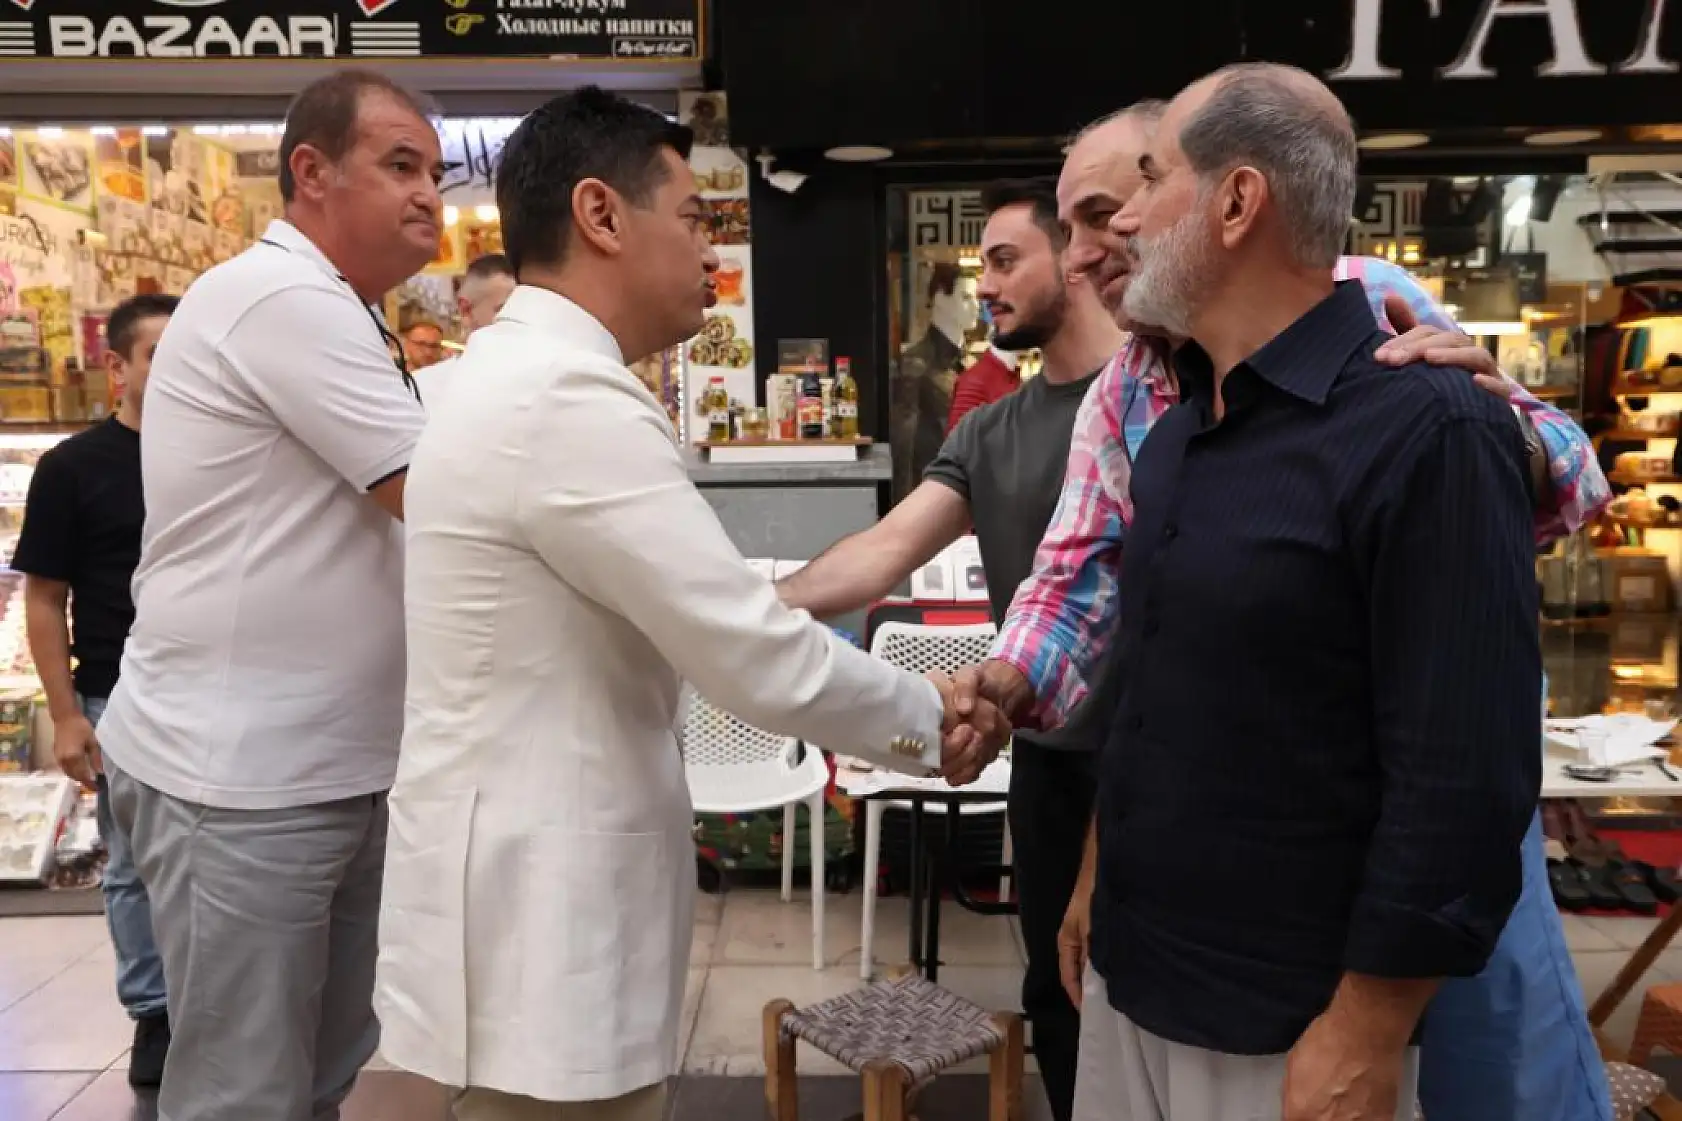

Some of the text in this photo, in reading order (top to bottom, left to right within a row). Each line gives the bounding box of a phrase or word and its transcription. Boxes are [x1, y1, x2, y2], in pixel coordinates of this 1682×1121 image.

[49, 15, 336, 57] BAZAAR
[496, 13, 694, 36] Холодные напитки
